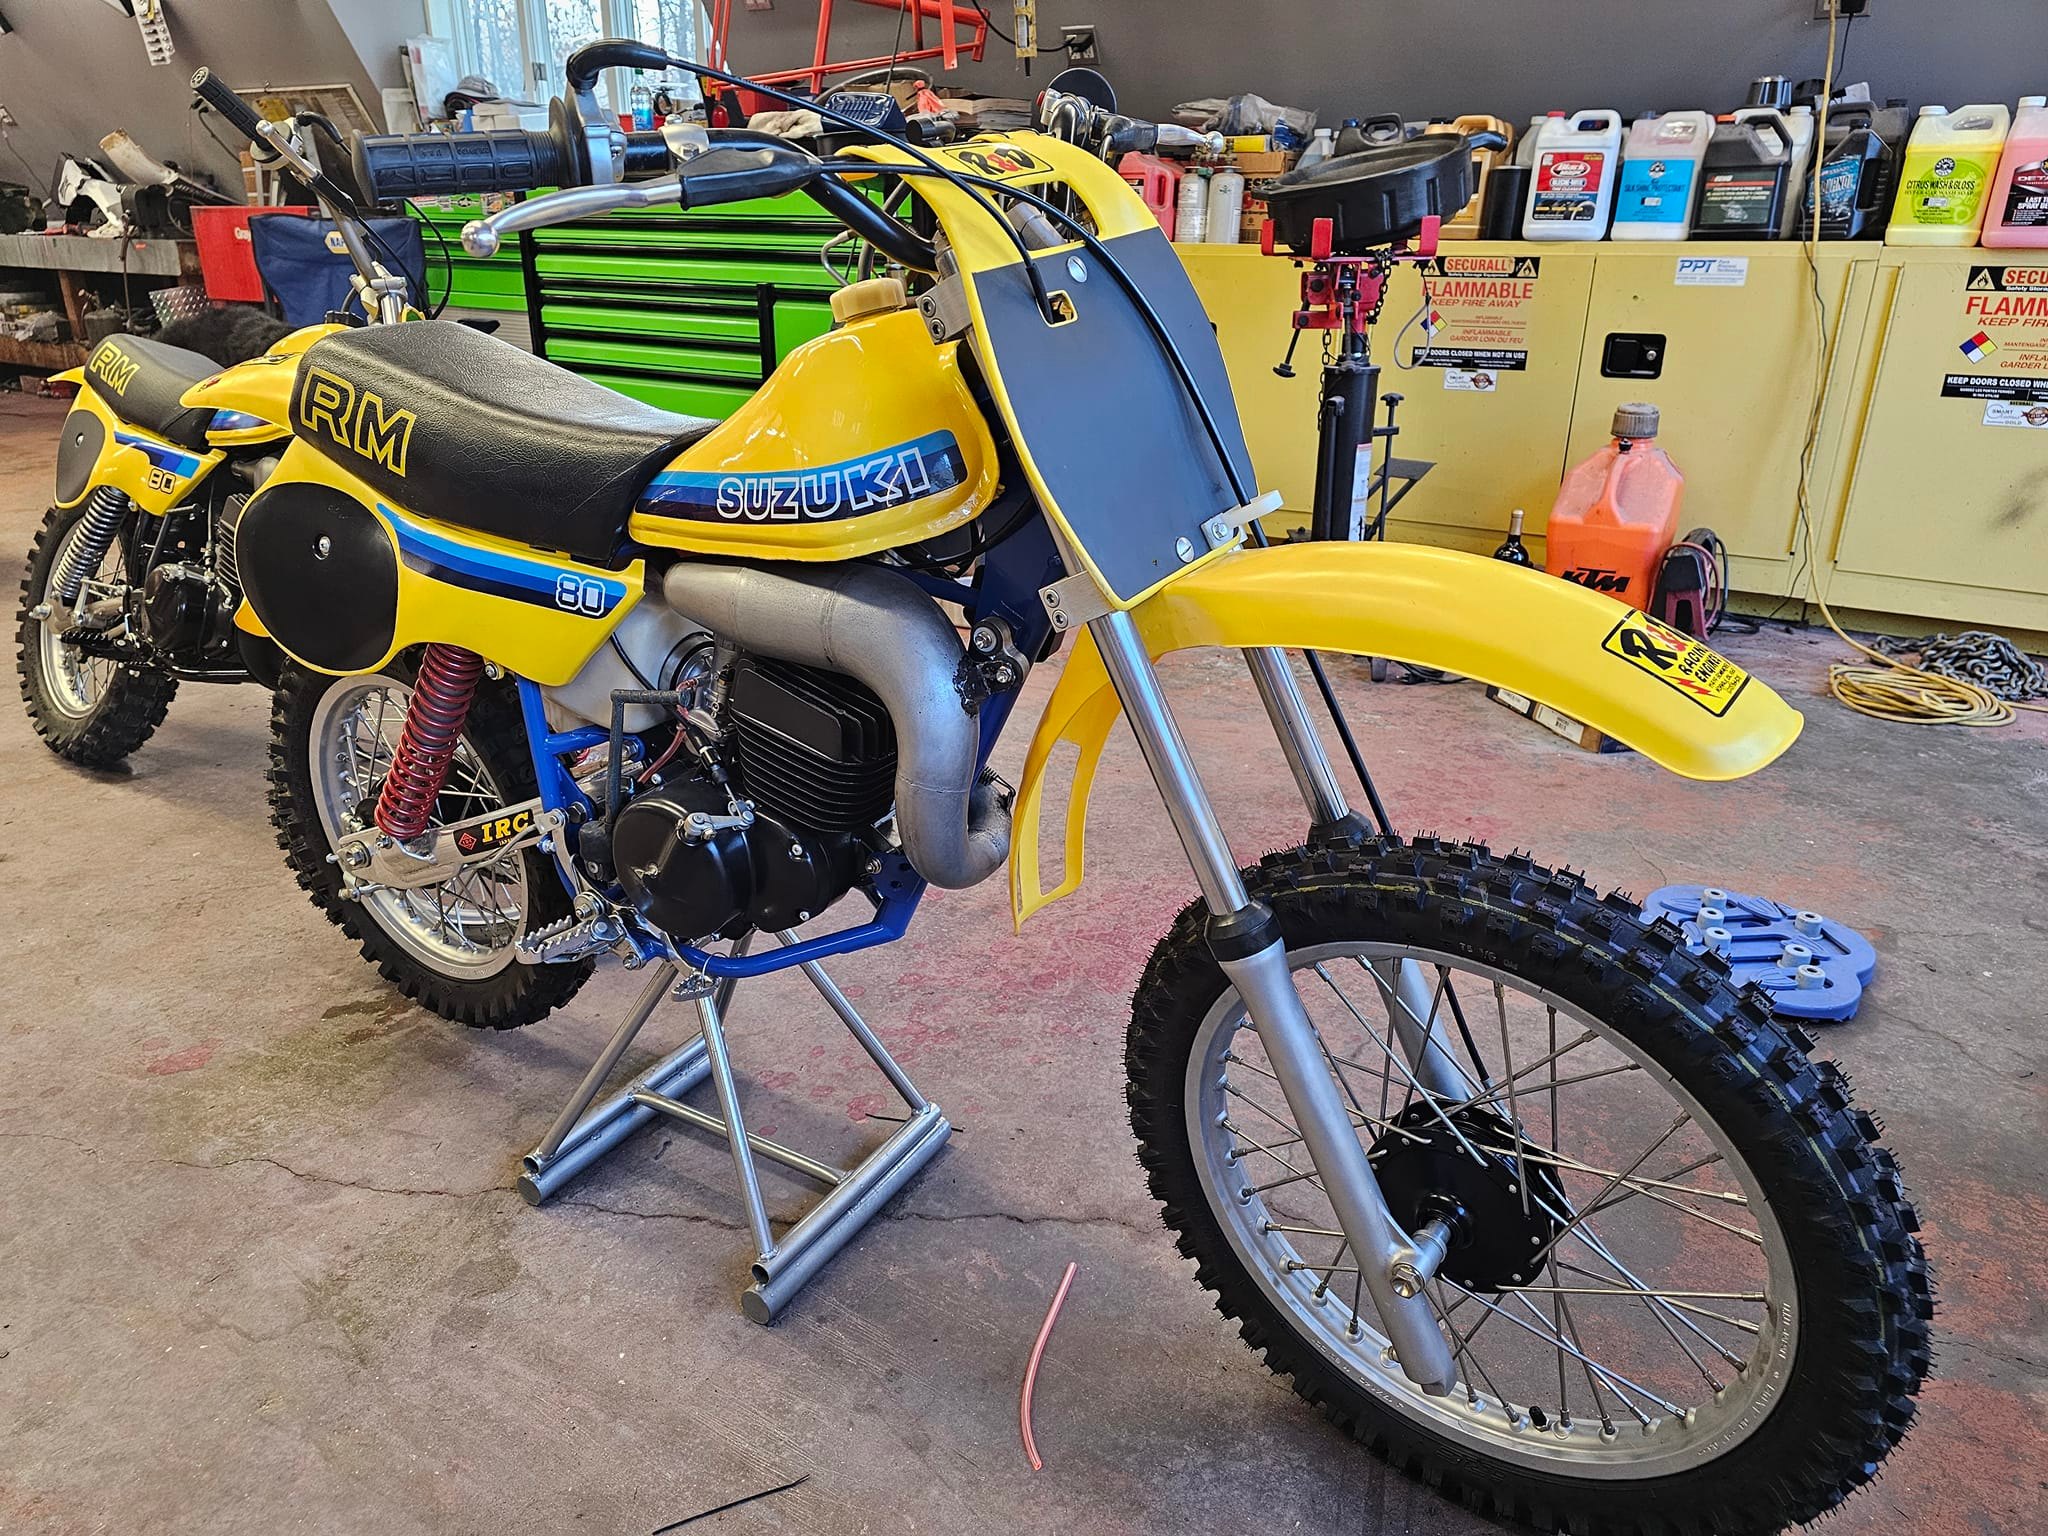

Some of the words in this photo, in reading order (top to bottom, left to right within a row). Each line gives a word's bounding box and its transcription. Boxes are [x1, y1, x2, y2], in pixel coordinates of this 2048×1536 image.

[1906, 180, 1930, 190] CITRUS
[1930, 180, 1948, 190] WASH
[1954, 180, 1976, 190] GLOSS
[1446, 258, 1508, 272] SECURALL
[1678, 259, 1717, 273] PPT
[1422, 280, 1534, 299] FLAMMABLE
[1431, 299, 1460, 307] KEEP
[1462, 299, 1487, 307] FIRE
[1488, 300, 1522, 308] AWAY
[1977, 317, 2019, 327] KEEP
[89, 341, 141, 397] RM
[1947, 376, 1970, 385] KEEP
[1970, 377, 1998, 386] DOORS
[1999, 378, 2032, 388] CLOSED
[301, 365, 417, 478] RM
[148, 467, 177, 495] 80
[716, 446, 931, 520] SUZUKI
[1560, 567, 1631, 593] KTM
[555, 573, 606, 616] 80
[481, 811, 529, 843] IRC
